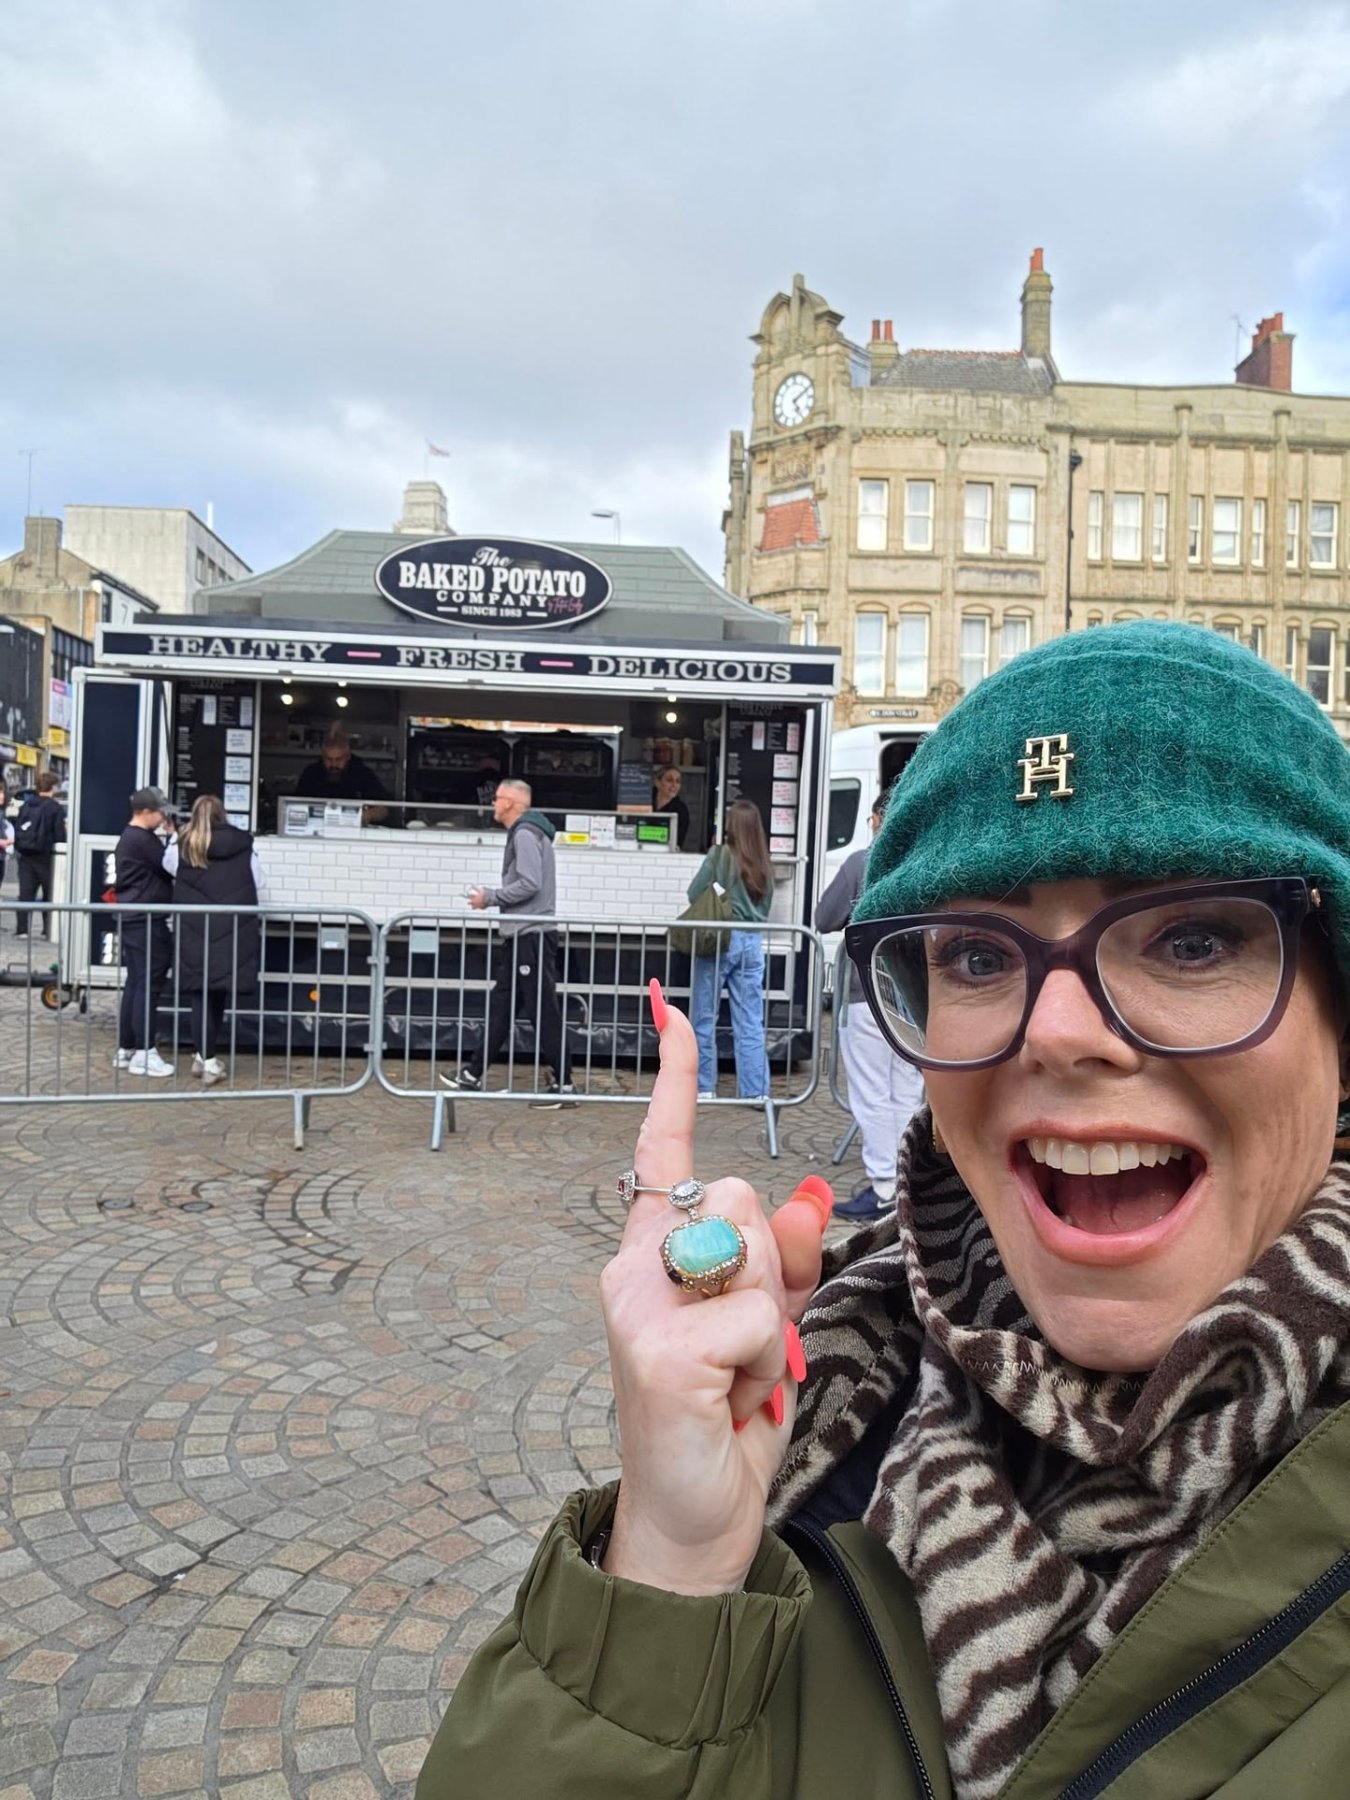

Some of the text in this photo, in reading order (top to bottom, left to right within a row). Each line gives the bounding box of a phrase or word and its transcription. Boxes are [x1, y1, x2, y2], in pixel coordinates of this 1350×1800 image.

[471, 546, 511, 568] The
[398, 561, 586, 598] BAKED POTATO
[436, 591, 548, 608] COMPANY
[461, 605, 498, 617] SINCE
[149, 635, 792, 683] HEALTHY FRESH DELICIOUS
